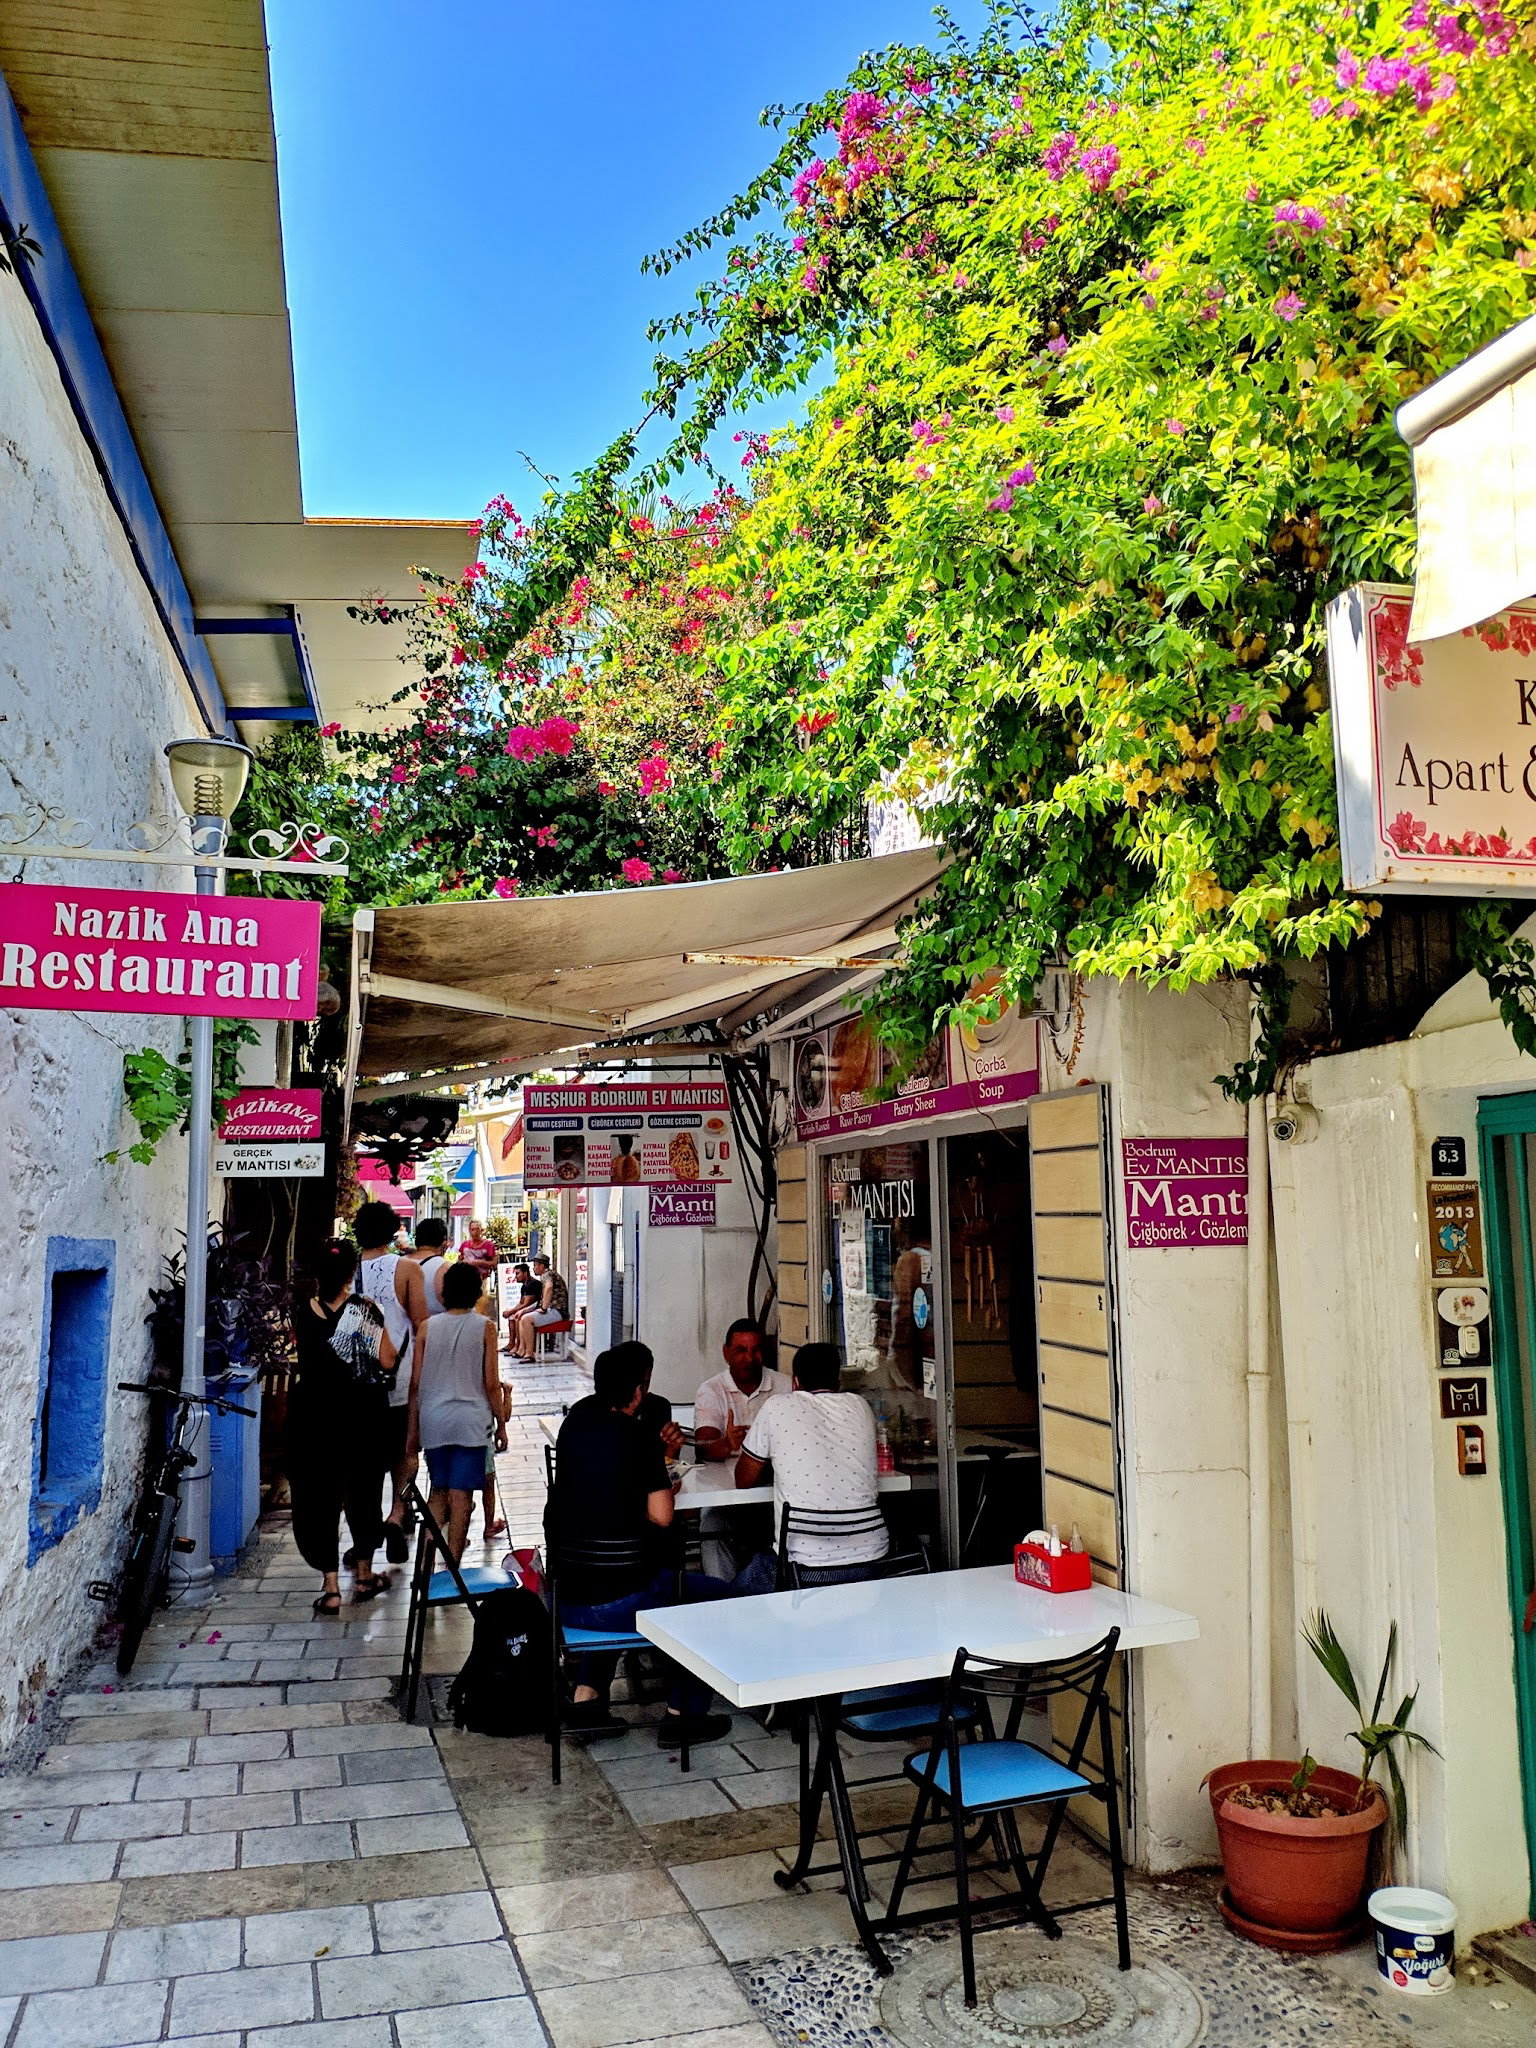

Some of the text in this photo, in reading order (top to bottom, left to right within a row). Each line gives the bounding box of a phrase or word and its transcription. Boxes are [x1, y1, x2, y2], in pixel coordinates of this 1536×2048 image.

[1395, 742, 1514, 806] Apart
[53, 902, 258, 947] Nazik Ana
[0, 942, 302, 1000] Restaurant
[975, 1055, 1006, 1078] Çorba
[530, 1089, 724, 1108] MEŞHUR BODRUM EV MANTISI
[979, 1082, 1004, 1099] Soup
[893, 1097, 936, 1116] Pastry Sheet
[839, 1112, 872, 1127] Raw Pastry
[224, 1125, 312, 1136] RESTAURANT
[233, 1149, 273, 1158] GERÇEK
[1125, 1143, 1176, 1156] Bodrum
[1438, 1149, 1459, 1163] 8,3
[216, 1160, 291, 1171] EV MANTISI
[831, 1158, 861, 1181] Bodrum
[1126, 1158, 1150, 1174] Ev
[666, 1184, 714, 1192] MANTISI
[651, 1194, 714, 1212] Mantı
[850, 1179, 915, 1218] MANTISI
[650, 1213, 680, 1225] Çiğbörek
[1435, 1206, 1474, 1219] 2013
[1130, 1220, 1187, 1245] Çiğbörek
[1200, 1219, 1248, 1239] Gözlem
[1402, 1953, 1445, 1975] Yoğurt
